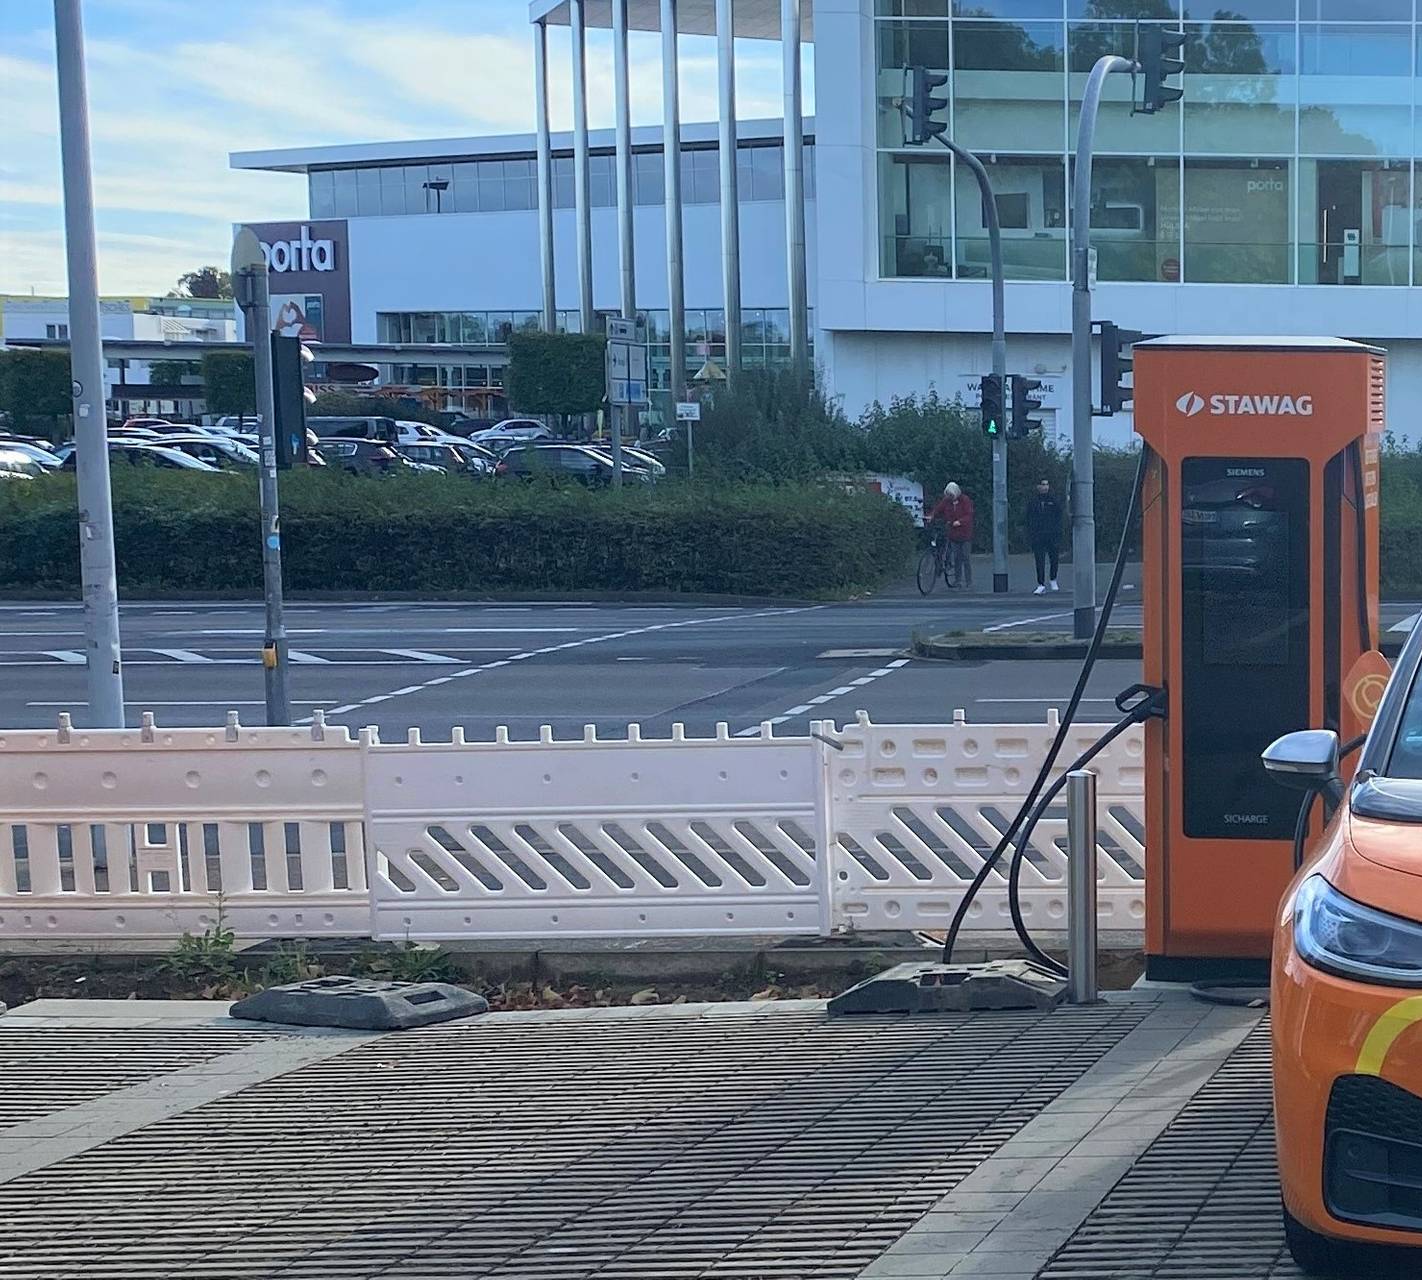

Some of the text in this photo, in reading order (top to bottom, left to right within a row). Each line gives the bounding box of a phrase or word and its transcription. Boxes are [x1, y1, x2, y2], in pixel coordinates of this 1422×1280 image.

[1247, 178, 1283, 192] porta
[1210, 395, 1313, 415] STAWAG
[1226, 468, 1265, 477] SIEMENS
[1223, 814, 1270, 824] SICHARGE
